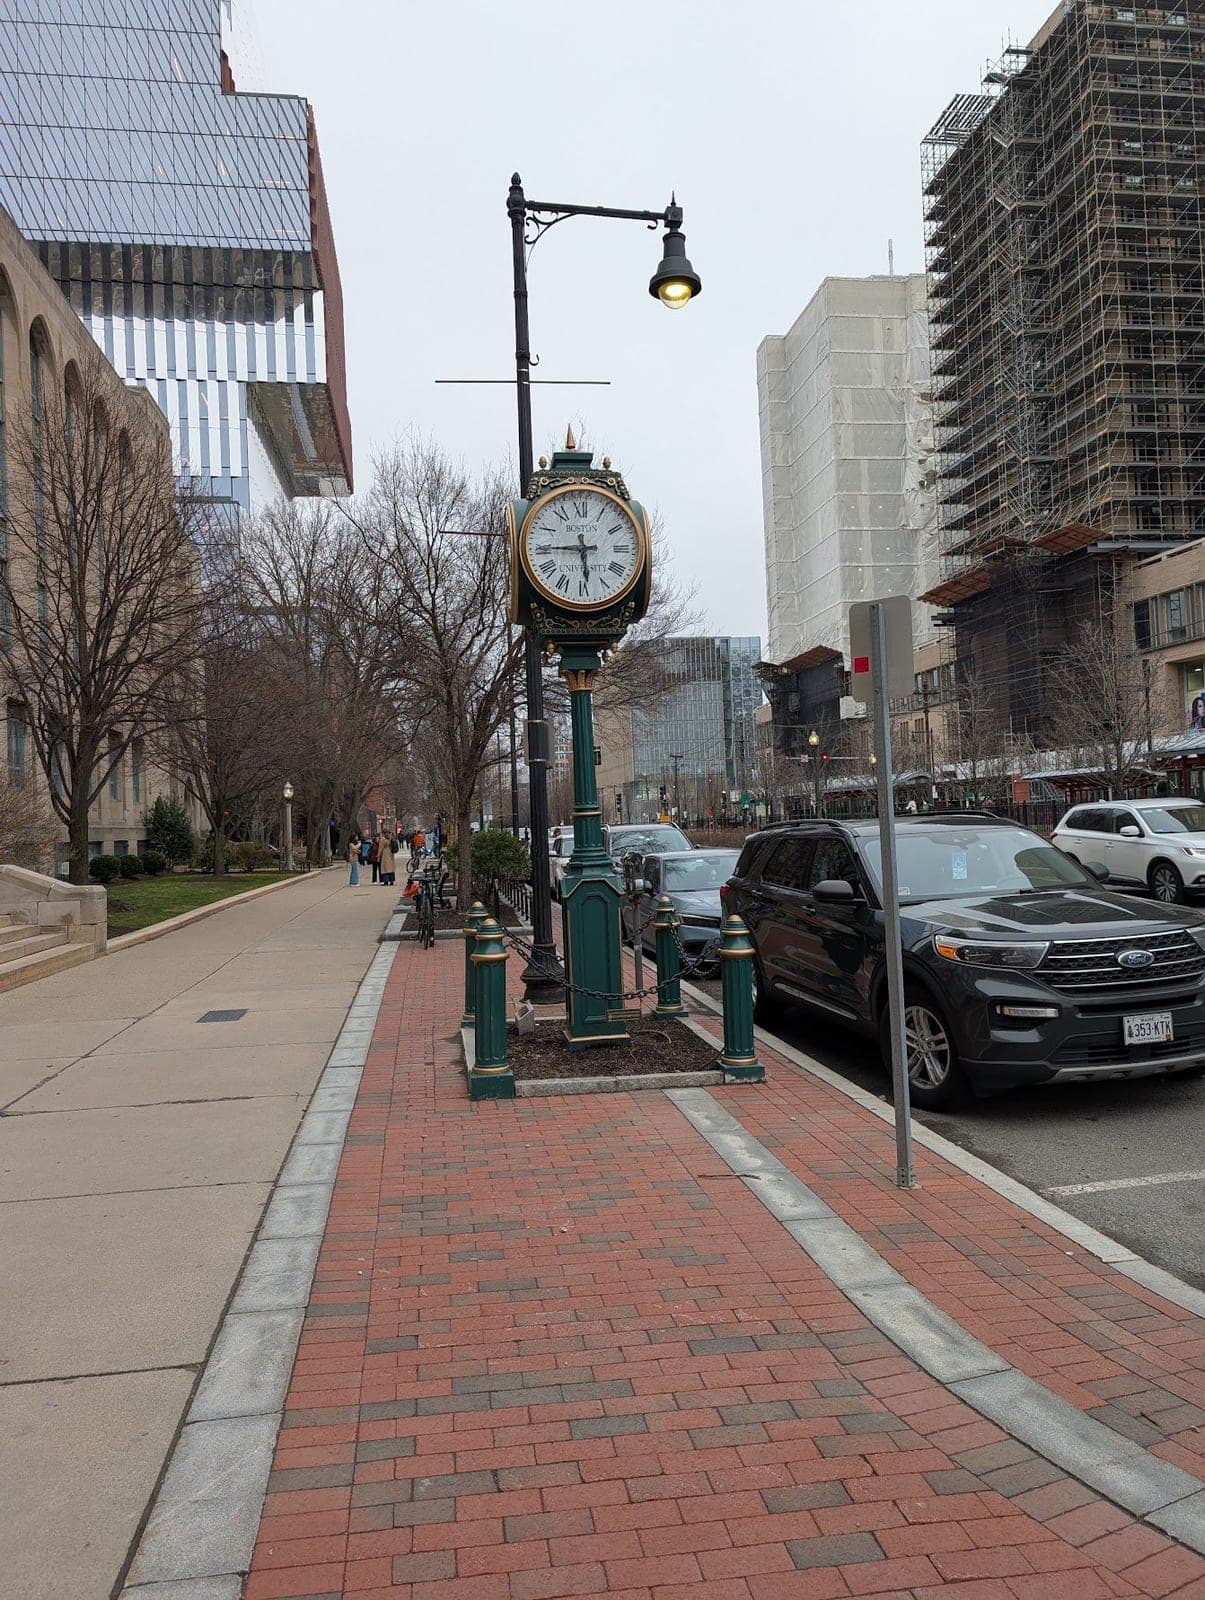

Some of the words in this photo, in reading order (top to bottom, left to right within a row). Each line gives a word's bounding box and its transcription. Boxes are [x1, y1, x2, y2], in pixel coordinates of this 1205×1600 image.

[574, 502, 588, 519] XII
[539, 523, 556, 536] X
[566, 525, 598, 533] BOSTON
[608, 524, 623, 535] II
[613, 545, 629, 553] III
[559, 564, 607, 573] UNIVESITY
[1127, 953, 1147, 964] Ford
